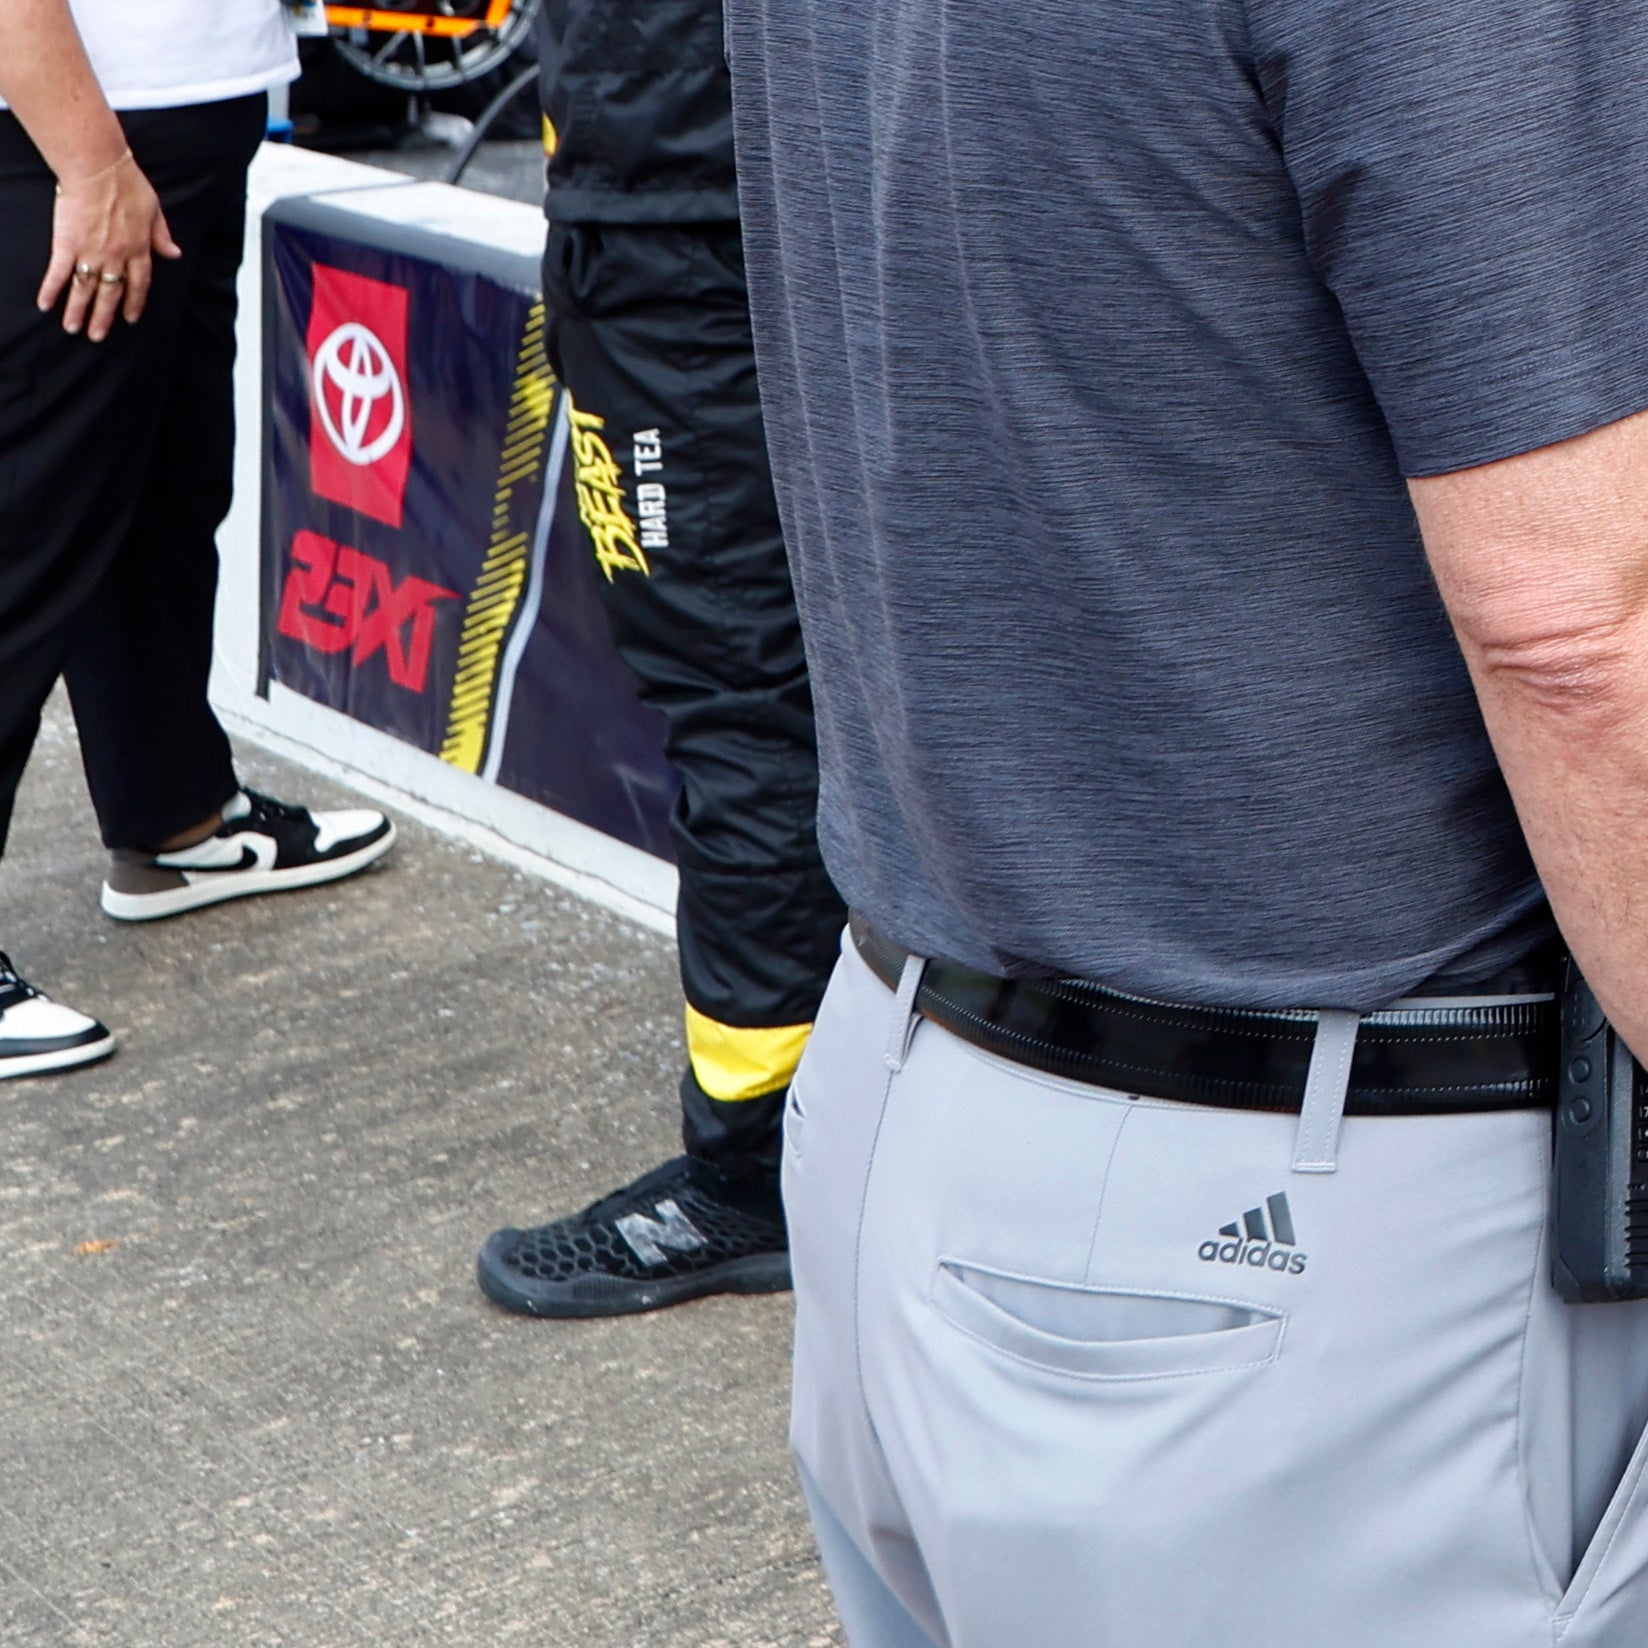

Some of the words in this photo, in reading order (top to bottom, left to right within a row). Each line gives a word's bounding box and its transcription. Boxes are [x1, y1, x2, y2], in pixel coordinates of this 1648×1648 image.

[632, 428, 664, 478] TEA
[566, 388, 651, 585] BEAST
[635, 483, 670, 550] HARD
[1197, 1236, 1307, 1276] adidas
